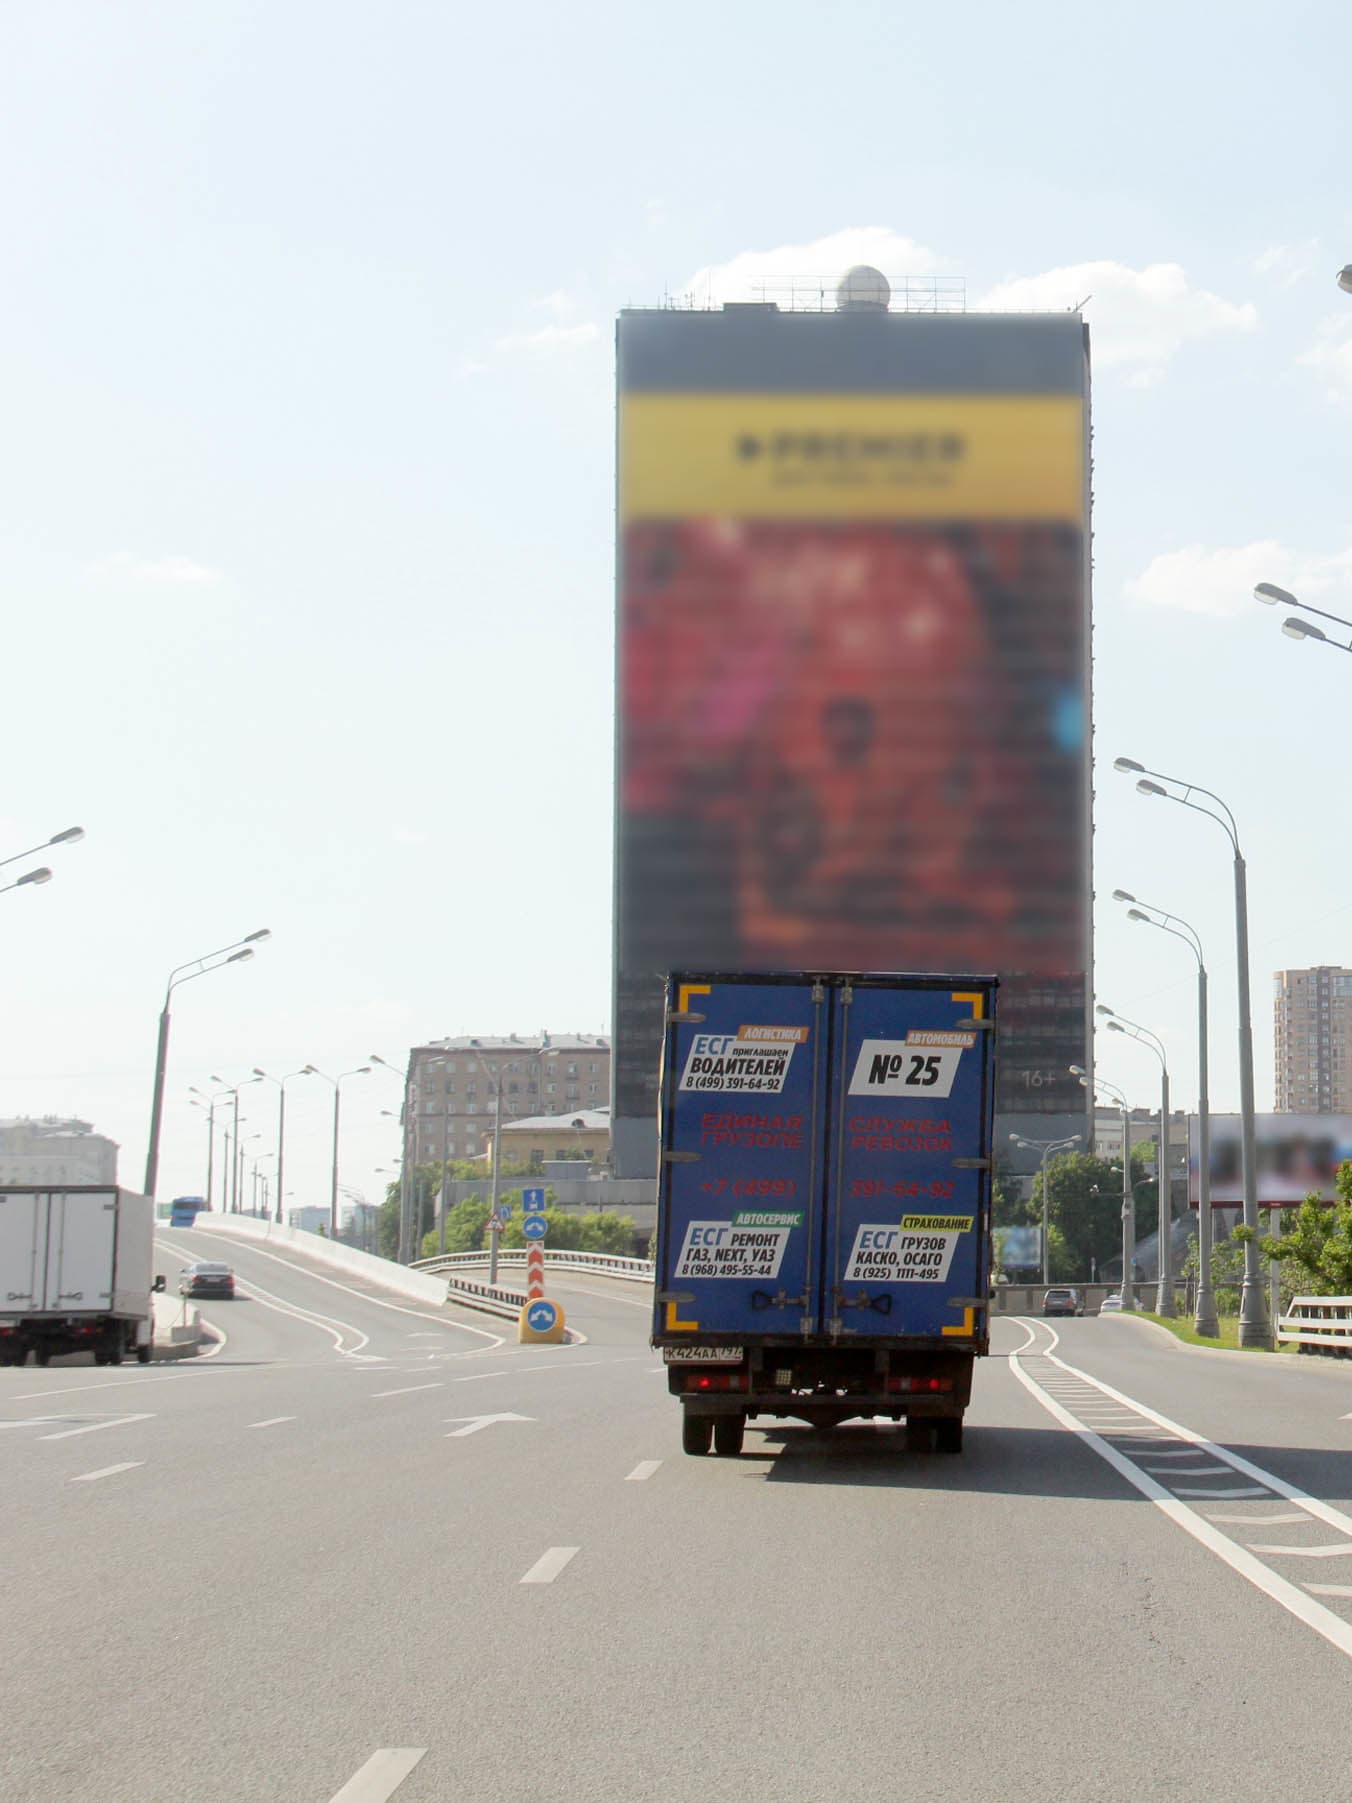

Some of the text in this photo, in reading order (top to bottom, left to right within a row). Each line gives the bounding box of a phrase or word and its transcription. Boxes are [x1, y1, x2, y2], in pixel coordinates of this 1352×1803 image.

[743, 1027, 802, 1041] ЛОГИСТИКА
[906, 1032, 975, 1047] АВТОМОБИЛЬ
[694, 1037, 789, 1058] ЕСГ приглашаем
[689, 1056, 786, 1077] ВОДИТЕЛЕЙ
[905, 1054, 942, 1087] 25
[686, 1076, 781, 1091] 8 (499) 391-64-92
[1021, 1070, 1057, 1090] 16+
[703, 1113, 951, 1135] ЕДИНАЯ СЛУЖБА
[702, 1130, 953, 1152] ГРУЗОПЕ РЕВОЗОК
[702, 1179, 956, 1199] +7 (499) 391-64-92
[736, 1213, 801, 1226] АВТОСЕРВИС
[903, 1217, 970, 1230] СТРАХОВАНИЕ
[690, 1227, 780, 1246] ЕСГ РЕМОНТ
[860, 1231, 947, 1250] ЕСГ ГРУЗОВ
[686, 1248, 776, 1263] ГАЗ, NEXT, УАЗ
[855, 1251, 943, 1267] КАСКО, ОСАГО
[682, 1264, 771, 1277] 8 (968) 495-55-44
[853, 1267, 861, 1278] 8
[862, 1267, 892, 1280] (925)
